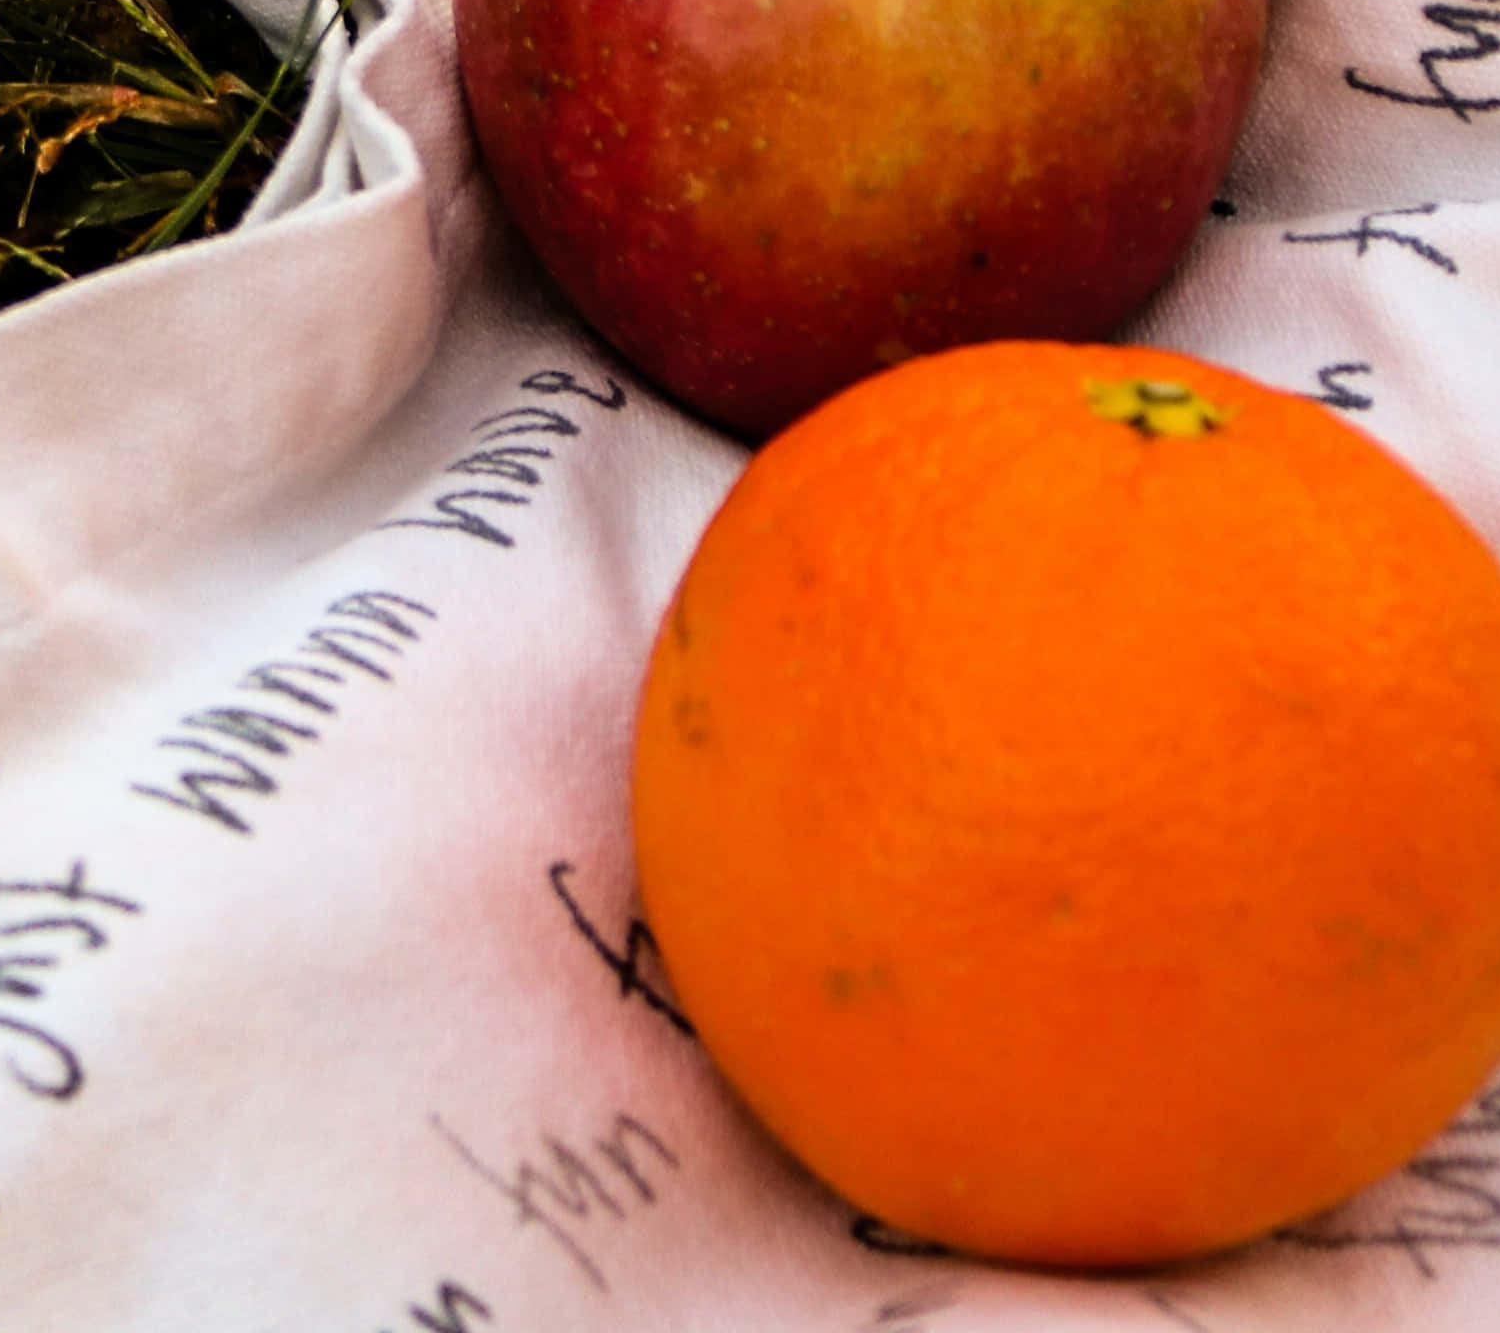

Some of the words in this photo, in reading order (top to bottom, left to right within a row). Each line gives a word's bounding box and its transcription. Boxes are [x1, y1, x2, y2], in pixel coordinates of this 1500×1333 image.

[129, 589, 440, 837] wanna
[376, 369, 626, 549] have
[426, 1109, 682, 1296] fun
